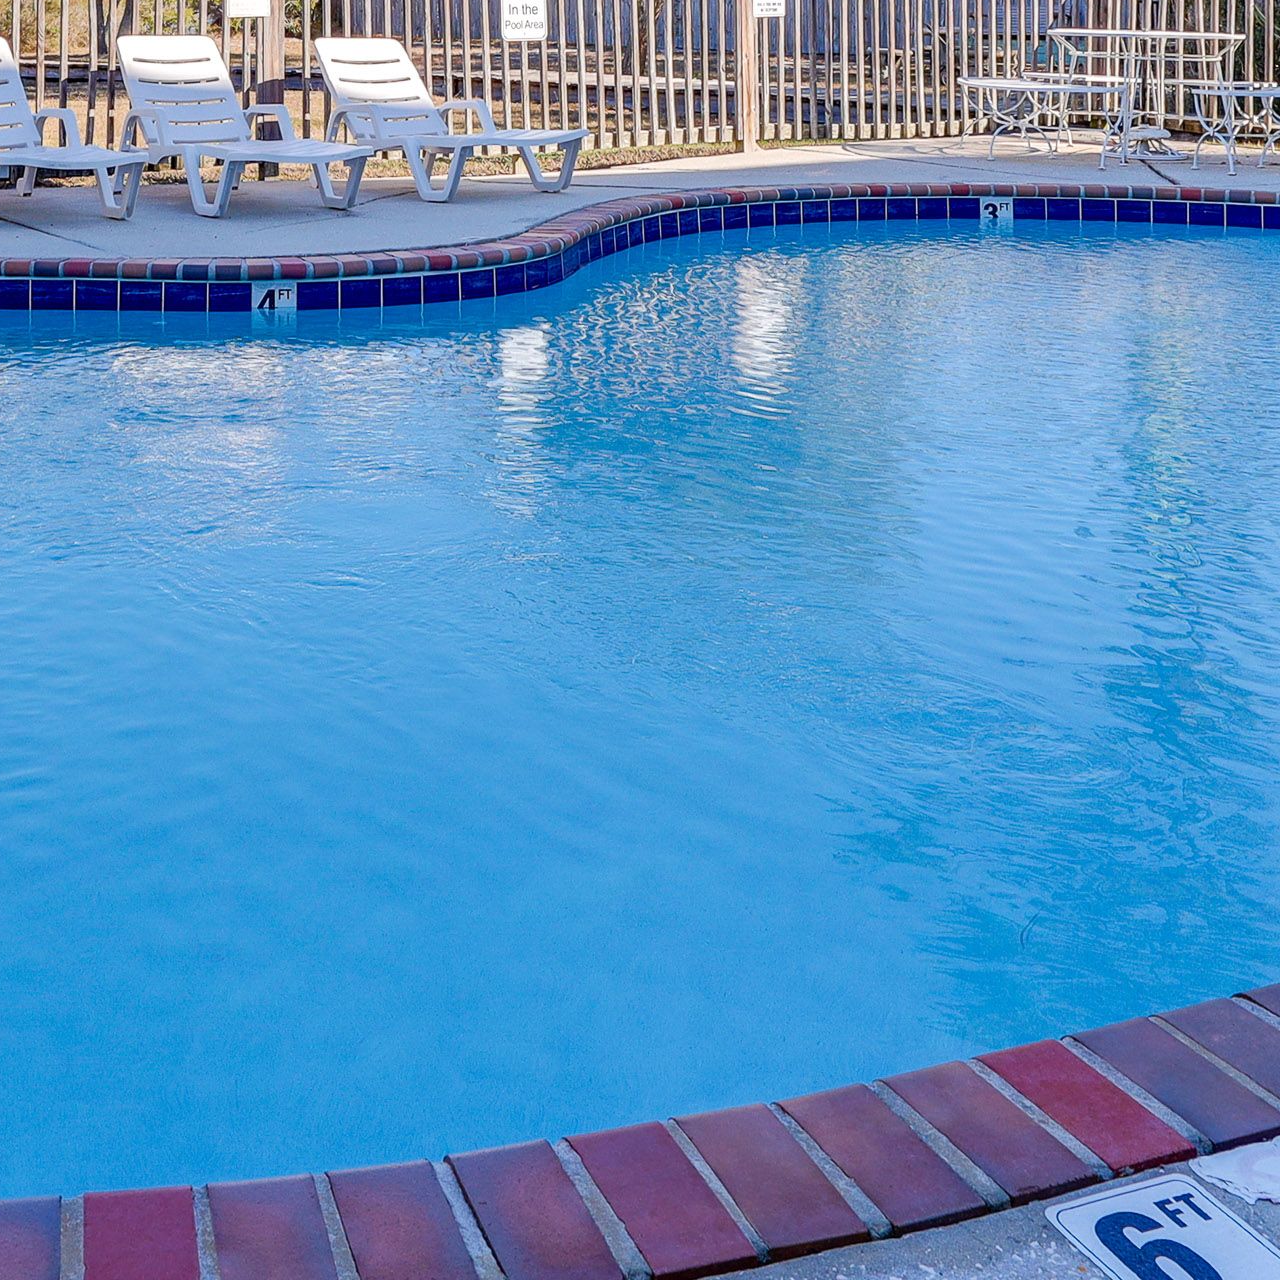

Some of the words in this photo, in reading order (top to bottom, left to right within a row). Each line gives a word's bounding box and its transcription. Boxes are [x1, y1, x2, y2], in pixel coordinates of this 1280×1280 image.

[508, 4, 519, 15] In
[521, 4, 539, 15] the
[505, 20, 524, 30] Pool
[524, 20, 544, 29] Area
[999, 203, 1010, 211] FT
[279, 289, 292, 300] FT
[1154, 1192, 1213, 1228] FT
